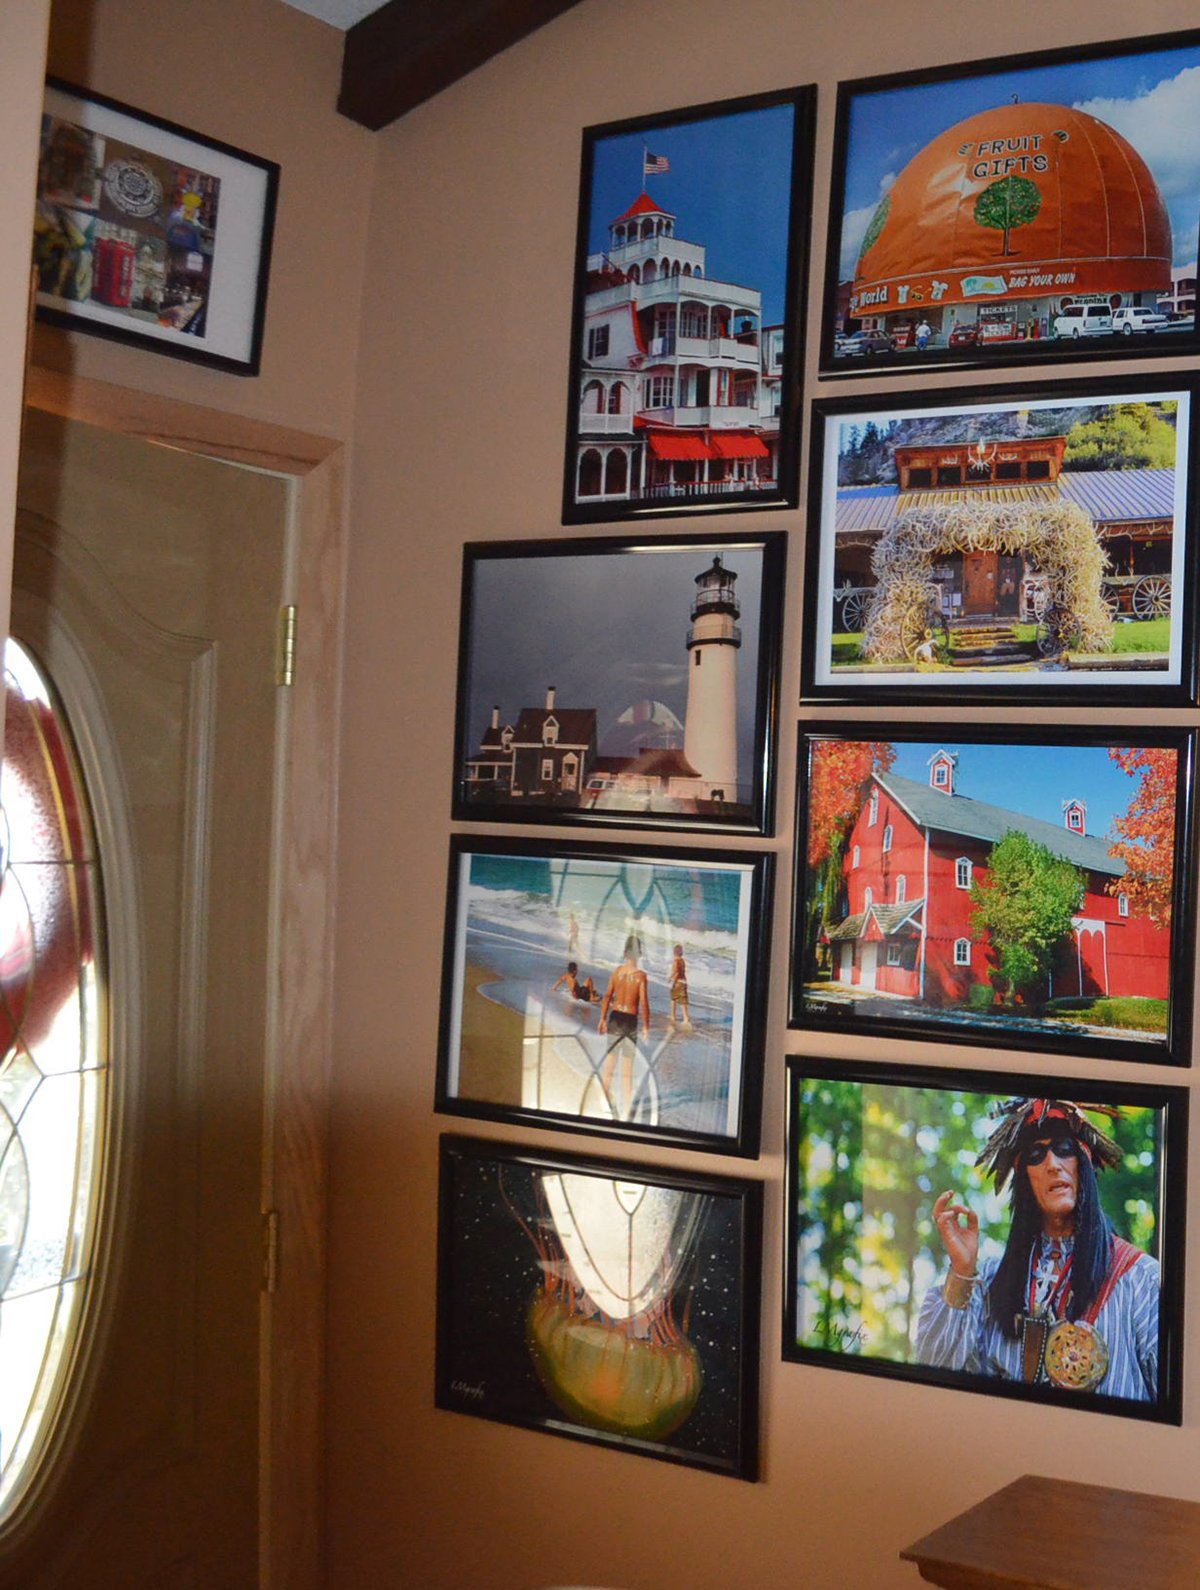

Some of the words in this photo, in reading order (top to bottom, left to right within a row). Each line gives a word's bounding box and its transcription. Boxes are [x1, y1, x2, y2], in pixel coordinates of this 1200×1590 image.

[977, 135, 1044, 157] FRUIT
[973, 155, 1048, 179] GIFTS
[1009, 276, 1028, 288] BAG
[1029, 273, 1054, 287] YOUR
[1055, 271, 1076, 284] OWN
